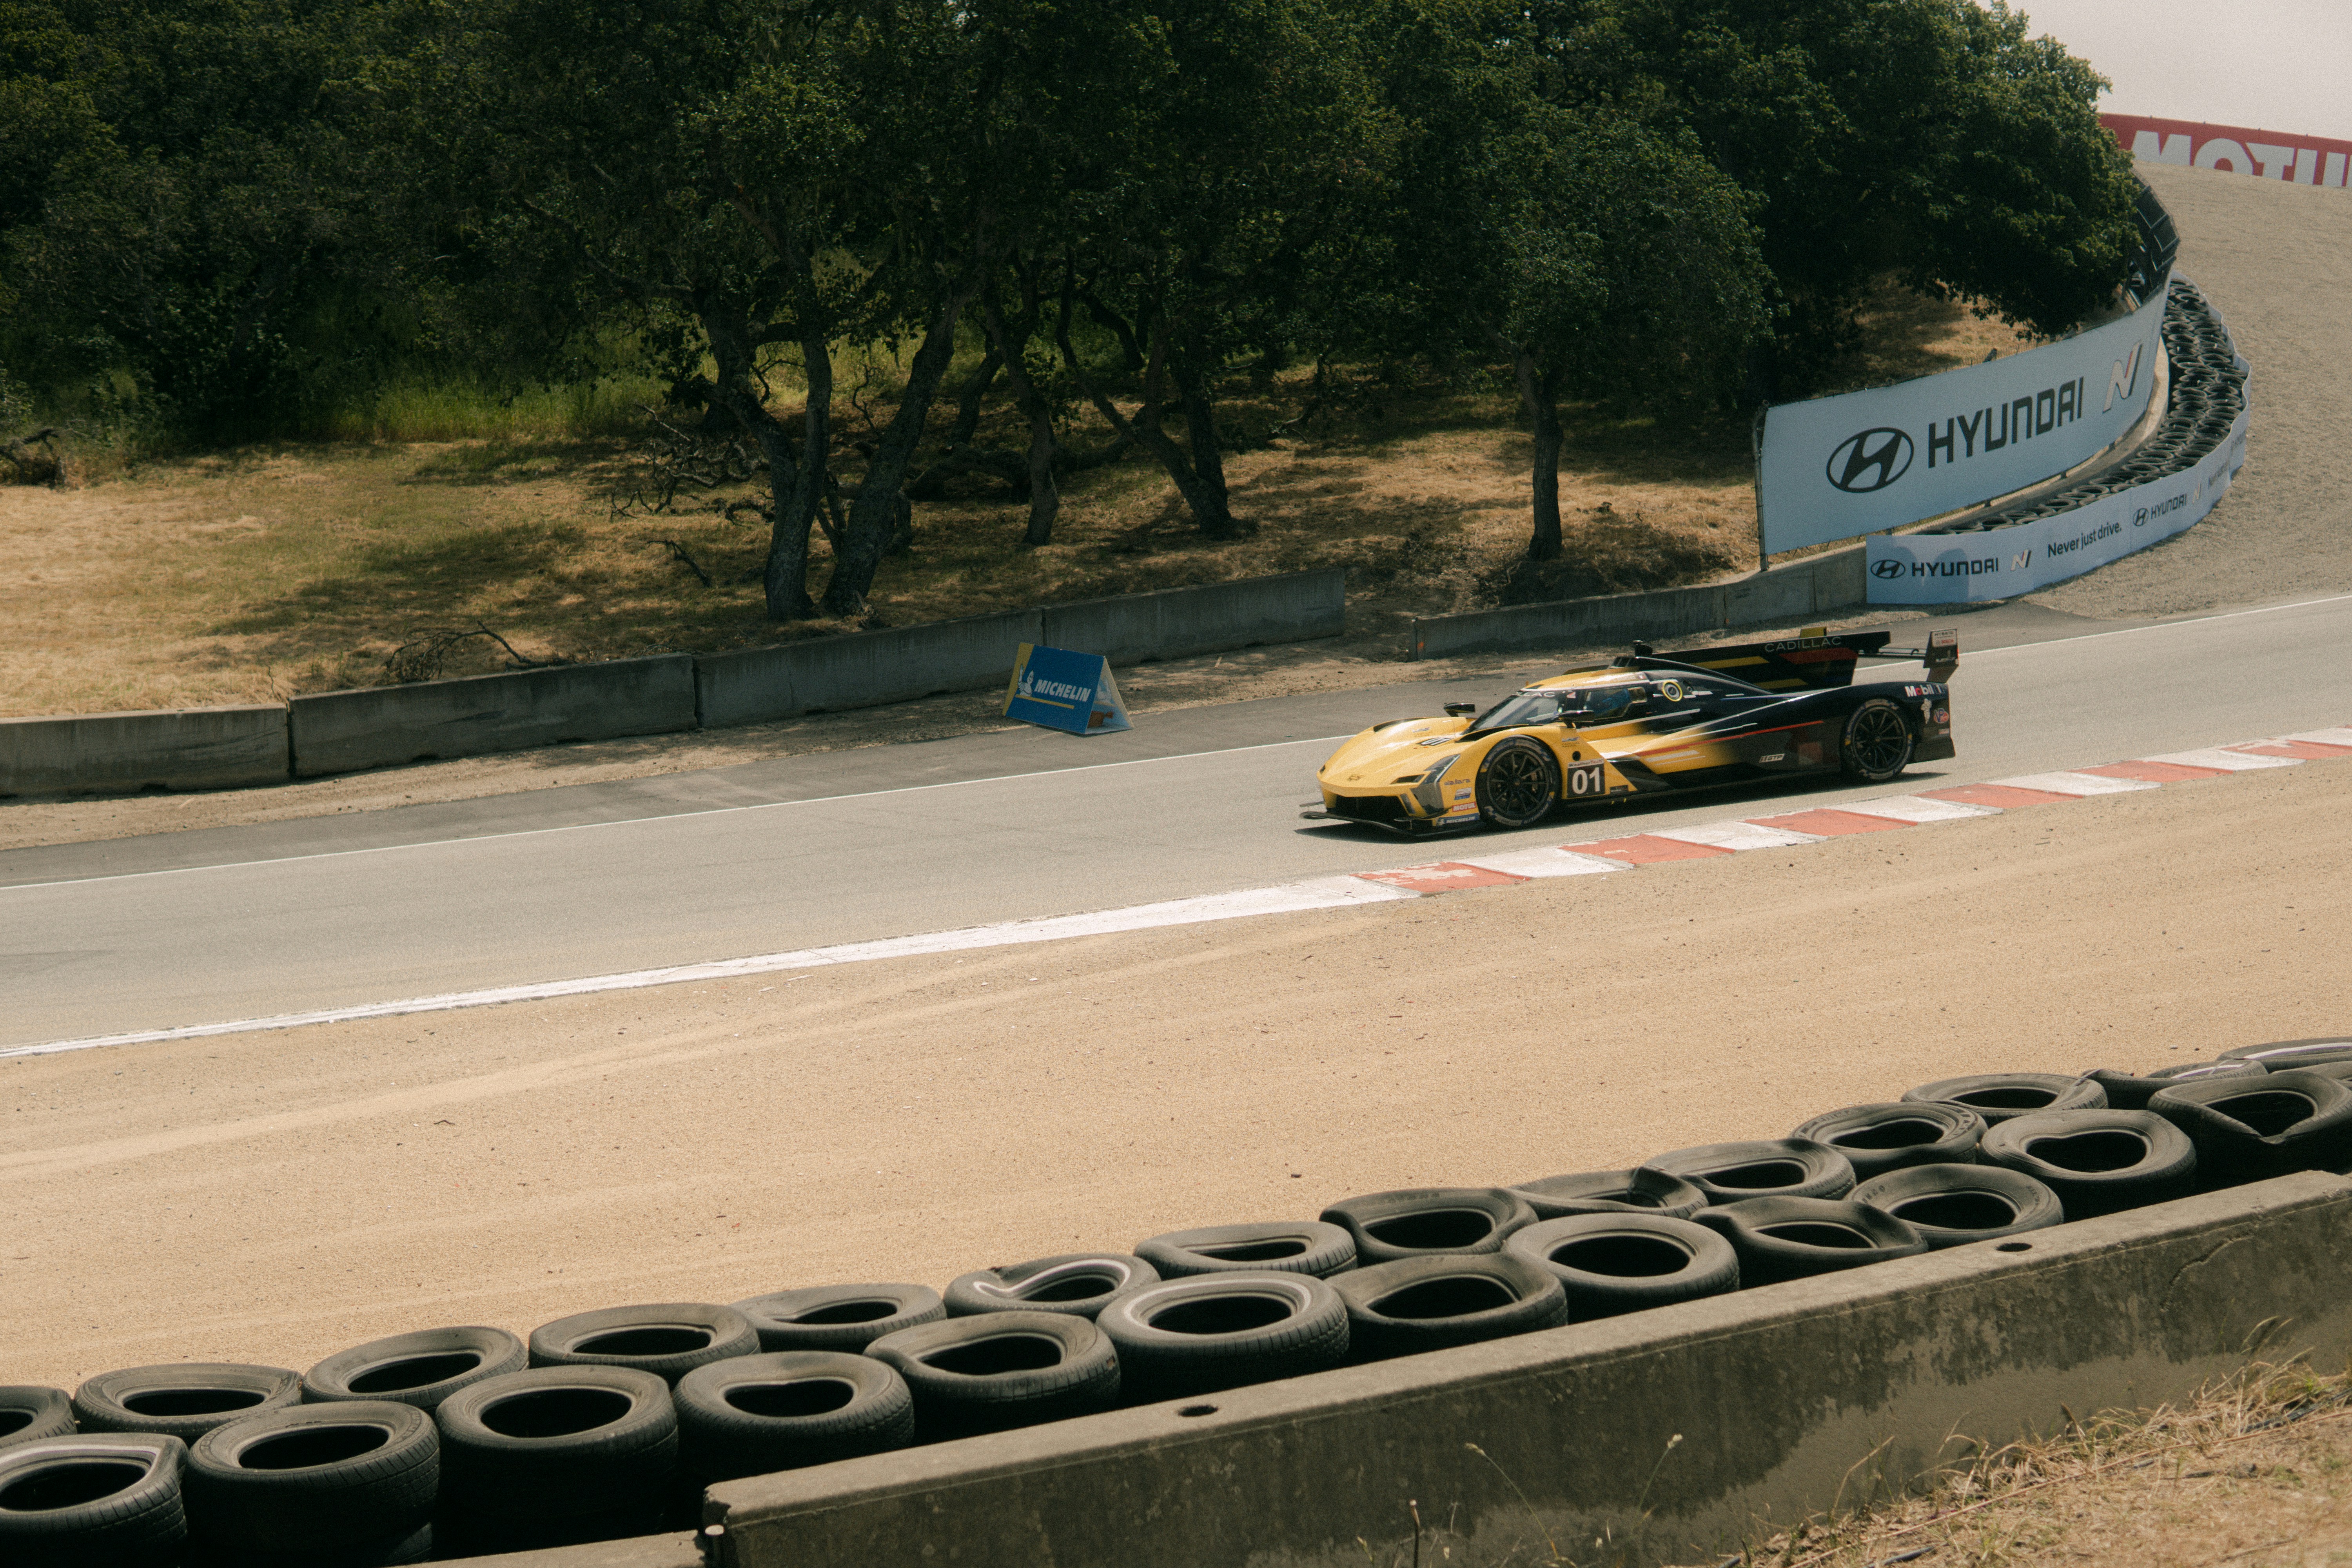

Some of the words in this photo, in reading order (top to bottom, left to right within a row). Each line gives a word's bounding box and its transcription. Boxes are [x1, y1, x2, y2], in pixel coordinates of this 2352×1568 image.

[2131, 130, 2352, 187] MOTU
[1928, 376, 2084, 468] HYUNDAI
[2151, 493, 2187, 519] HYUNDAI
[2048, 537, 2079, 558] Never
[2081, 529, 2096, 550] just
[2098, 521, 2122, 539] drive.
[1912, 557, 1999, 577] HYUNDAI
[1765, 636, 1841, 652] CADILLAC
[1034, 679, 1091, 702] MICHELIN
[1904, 684, 1934, 697] Mobil
[1572, 767, 1601, 794] 01
[1453, 802, 1475, 811] MOTUL
